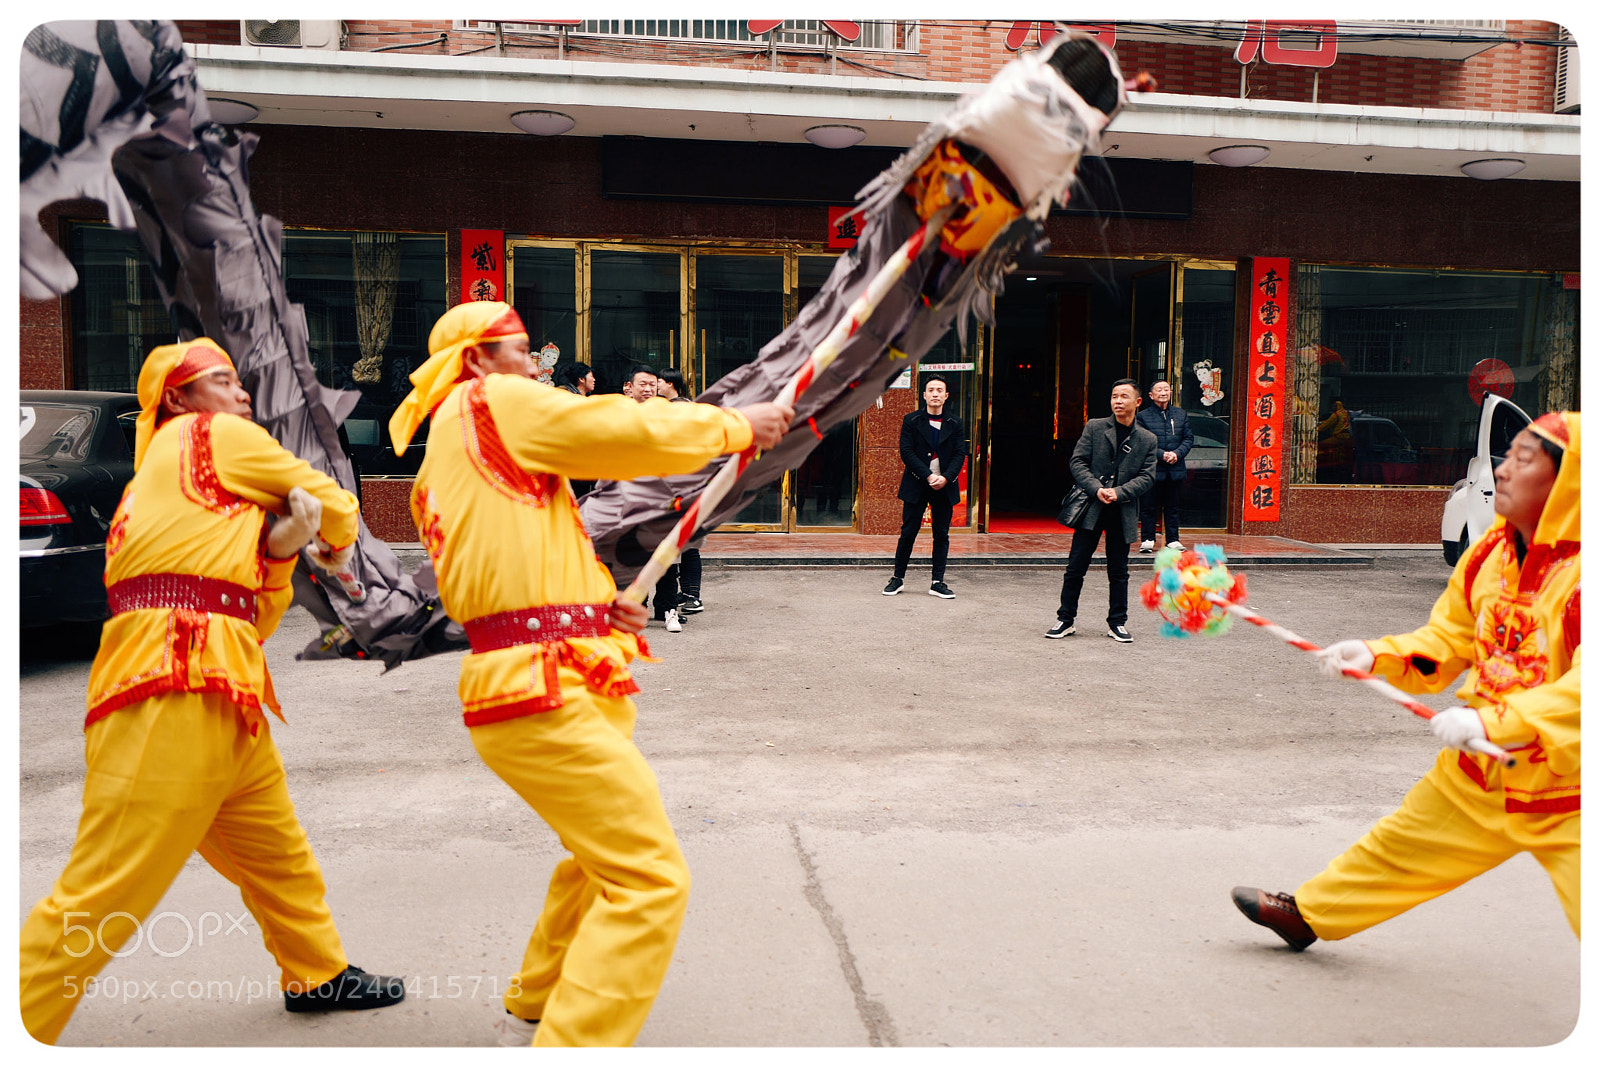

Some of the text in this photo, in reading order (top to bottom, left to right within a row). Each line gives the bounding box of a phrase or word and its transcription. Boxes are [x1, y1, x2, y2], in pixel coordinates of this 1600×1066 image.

[471, 240, 497, 301] 紫氣
[1252, 267, 1283, 510] 青雲直上酒店興旺
